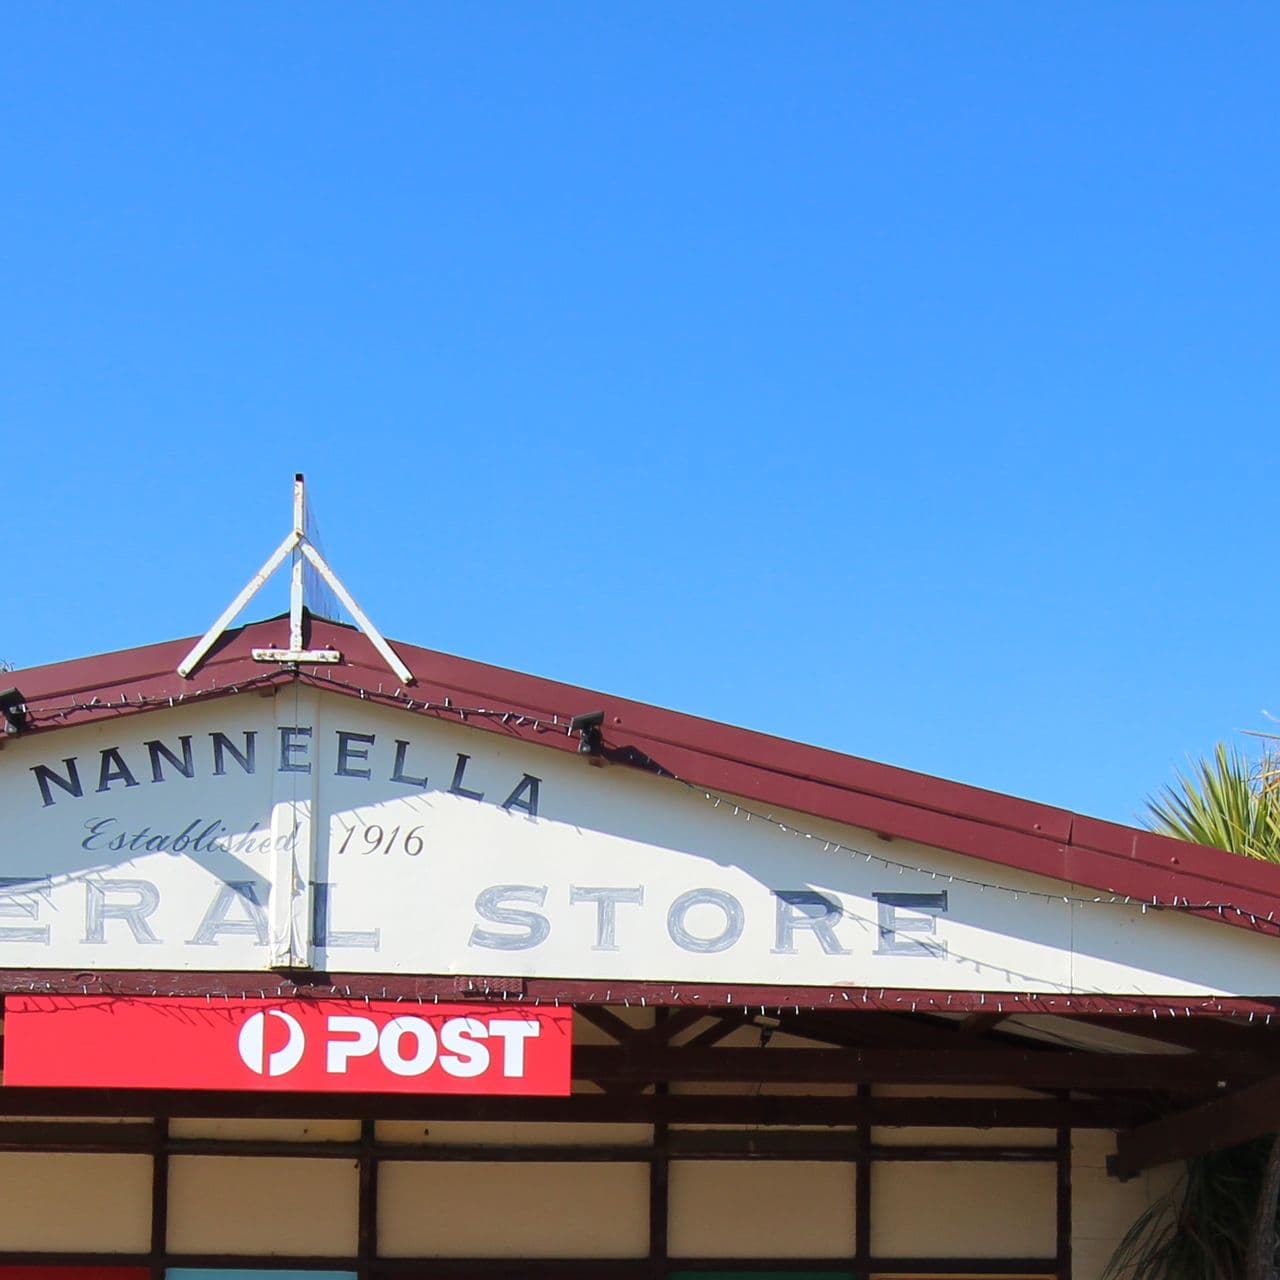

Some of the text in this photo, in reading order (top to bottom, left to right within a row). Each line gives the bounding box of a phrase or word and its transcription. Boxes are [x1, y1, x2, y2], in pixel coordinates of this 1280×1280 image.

[29, 726, 542, 823] NANNEELLA
[81, 817, 424, 857] Established 1916
[469, 884, 949, 956] STORE
[326, 1015, 539, 1077] POST
